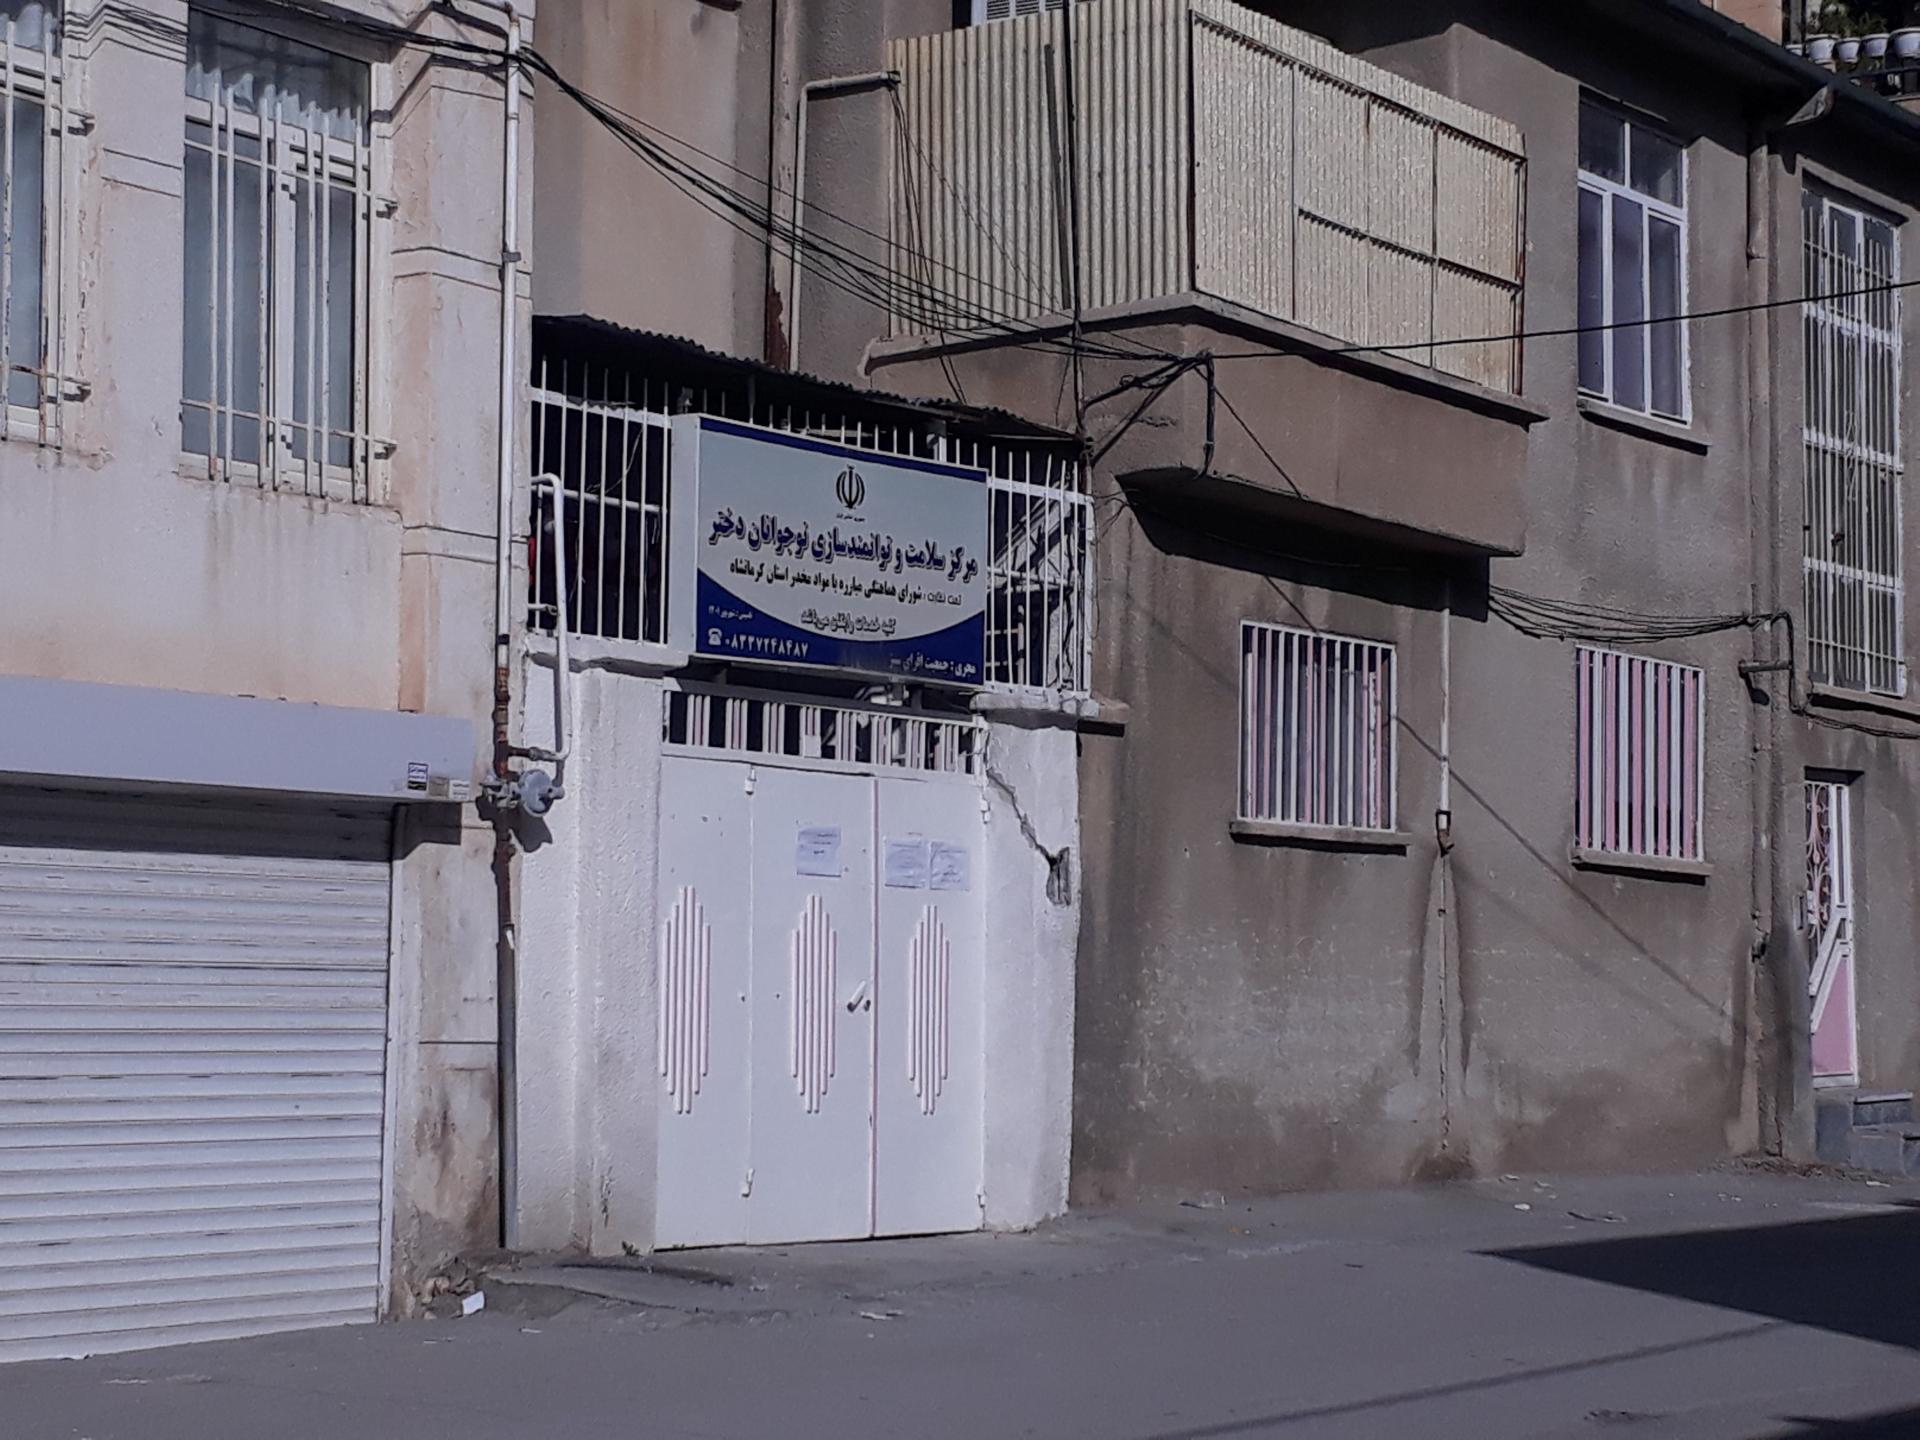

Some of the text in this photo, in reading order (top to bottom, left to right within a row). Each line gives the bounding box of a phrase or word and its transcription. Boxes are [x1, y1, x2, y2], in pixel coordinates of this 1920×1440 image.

[709, 507, 746, 546] دختر
[748, 513, 809, 560] نوجوانان
[894, 548, 903, 575] و
[905, 539, 946, 572] سلامت
[947, 546, 978, 584] مرکز
[730, 557, 765, 582] کرمانشاه
[767, 564, 788, 584] استان
[790, 569, 811, 587] مخدر
[813, 572, 830, 592] مواد
[831, 573, 838, 593] با
[864, 579, 896, 598] هماهنگی
[898, 583, 922, 604] شورای
